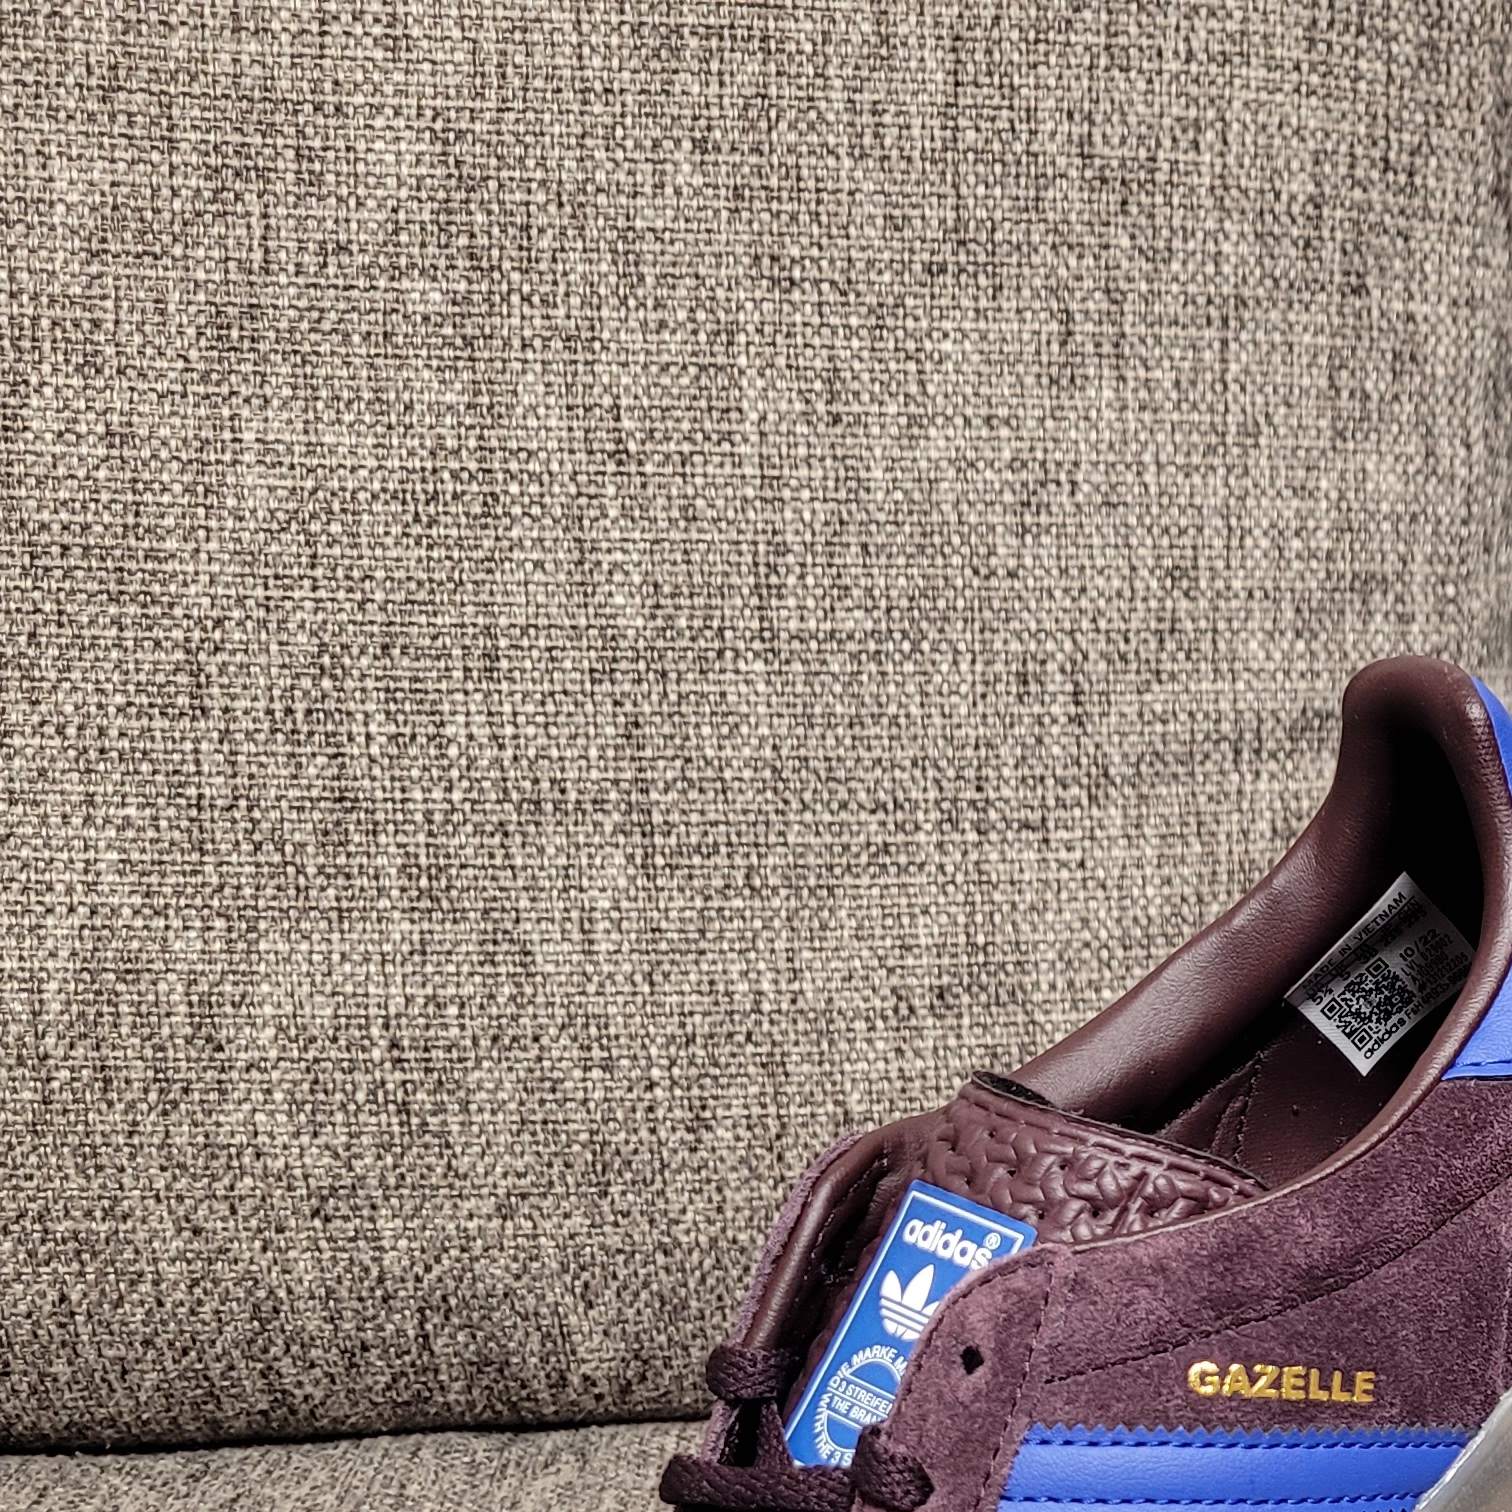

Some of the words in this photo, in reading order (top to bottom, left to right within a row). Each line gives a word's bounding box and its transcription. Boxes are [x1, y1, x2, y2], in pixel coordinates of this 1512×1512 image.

[1302, 958, 1336, 990] MADE
[1339, 943, 1352, 957] IN
[1353, 891, 1407, 941] VIETNAM
[1399, 928, 1440, 962] 10/22
[1364, 1017, 1407, 1059] adidas
[902, 1218, 993, 1270] adidas
[851, 1345, 898, 1366] MARKE
[1187, 1360, 1377, 1403] GAZELLE
[830, 1395, 852, 1414] THE
[849, 1405, 882, 1424] BRAN
[815, 1433, 835, 1459] THE
[831, 1451, 841, 1464] 3
